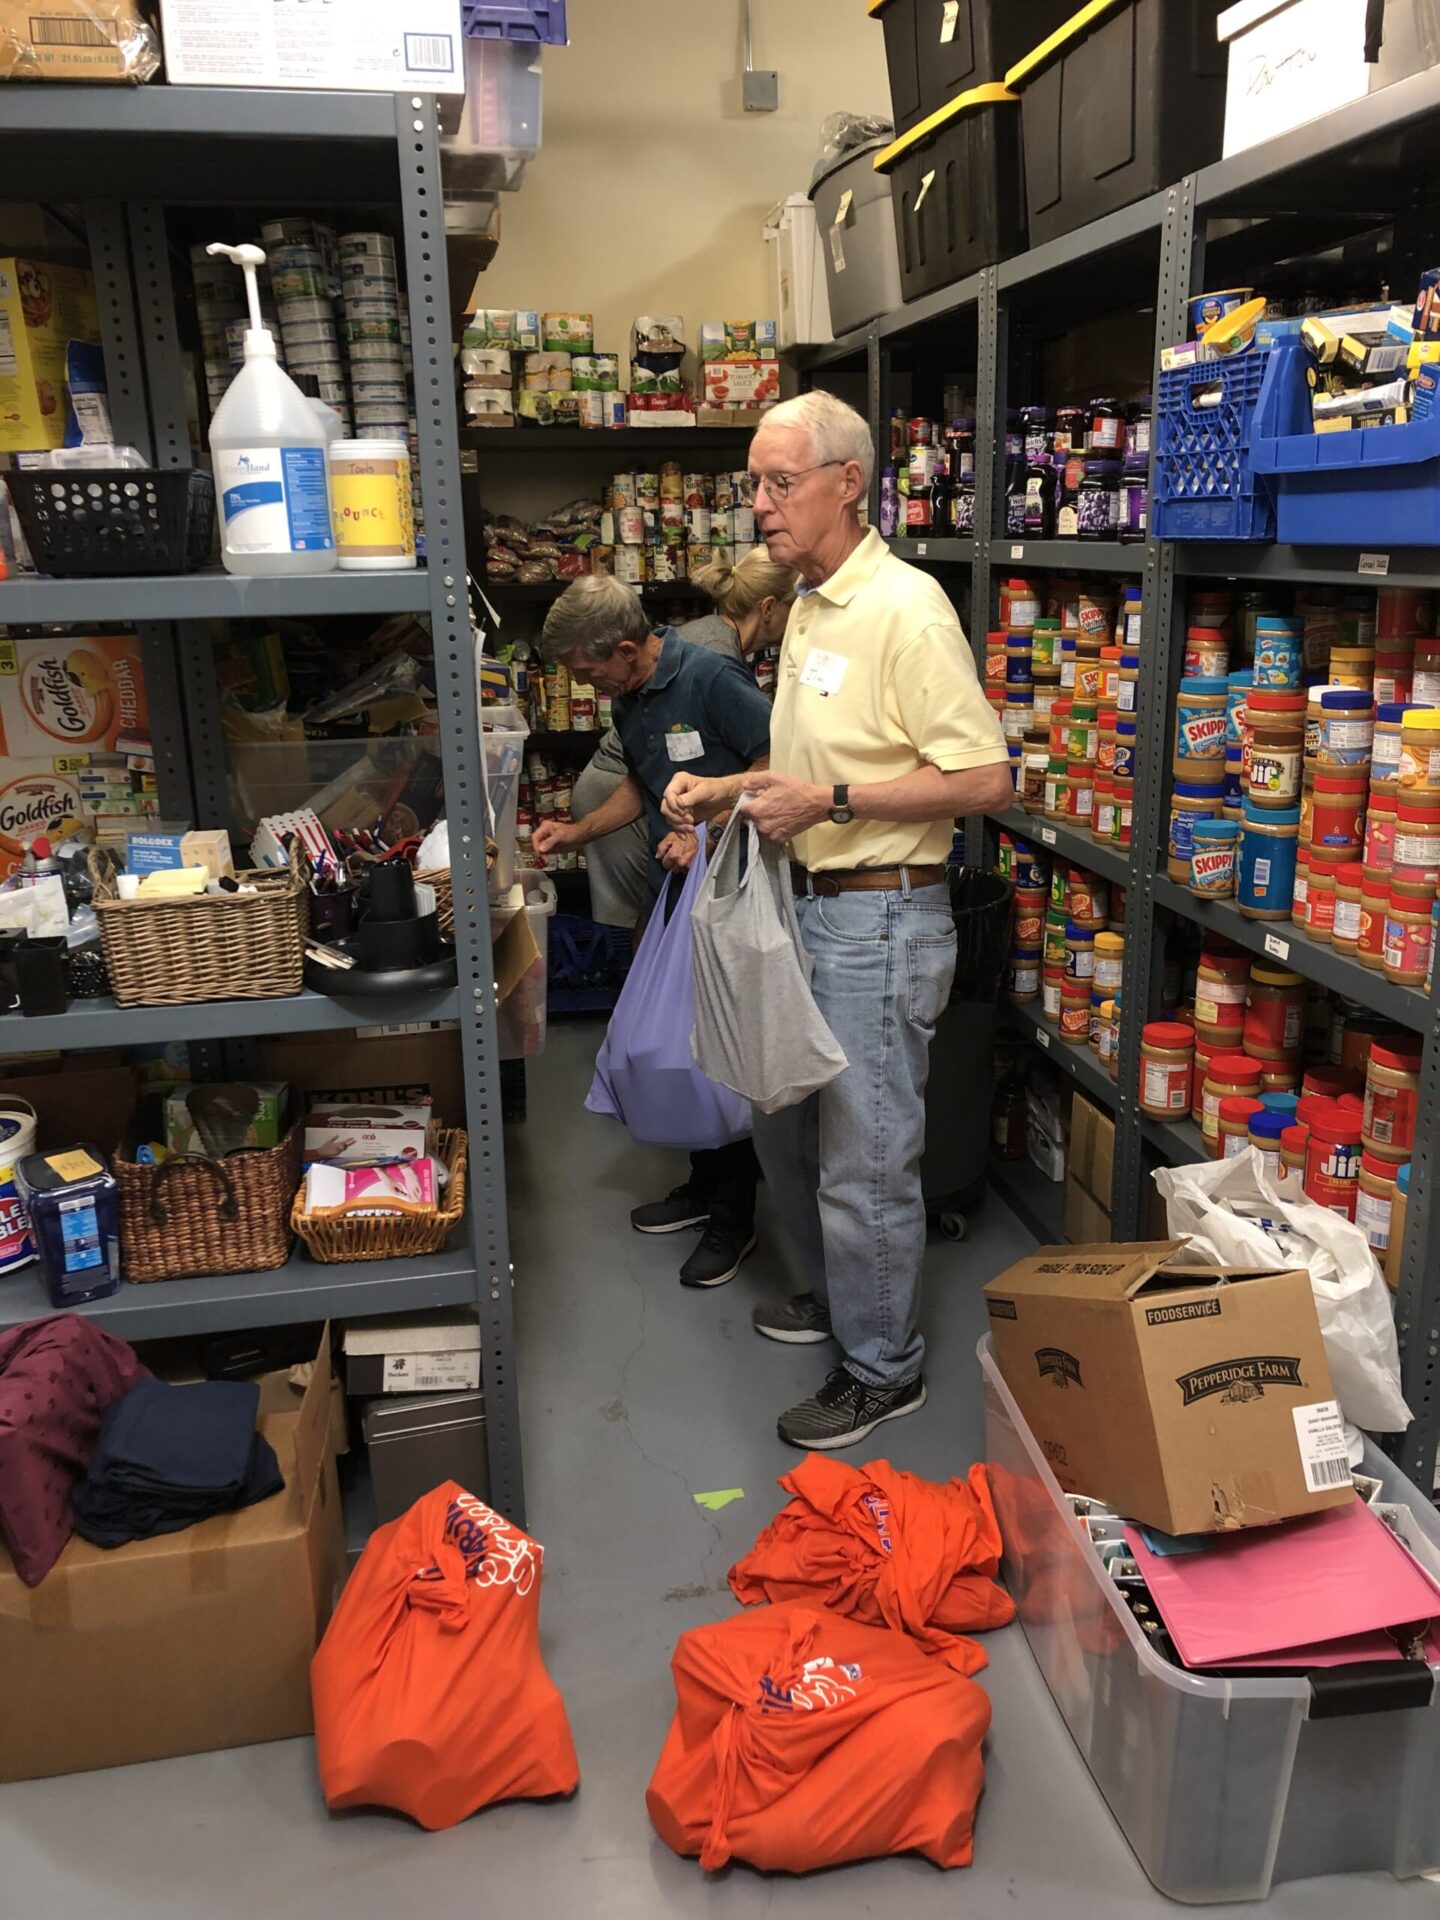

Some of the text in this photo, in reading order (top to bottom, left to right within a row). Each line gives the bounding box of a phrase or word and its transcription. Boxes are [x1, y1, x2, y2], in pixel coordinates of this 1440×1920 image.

[38, 656, 86, 732] Goldfish
[112, 658, 138, 729] CHEDDAR
[1188, 719, 1226, 742] SKIPPY
[59, 759, 69, 771] 3
[1251, 763, 1277, 784] Jif
[0, 792, 75, 831] Goldfish
[131, 836, 174, 847] ROLODEX
[1195, 853, 1233, 875] SKIPPY
[1320, 1154, 1361, 1177] Jif
[1148, 1301, 1219, 1323] FOODSERVICE
[1190, 1361, 1290, 1394] PEPPERIDGE FARM
